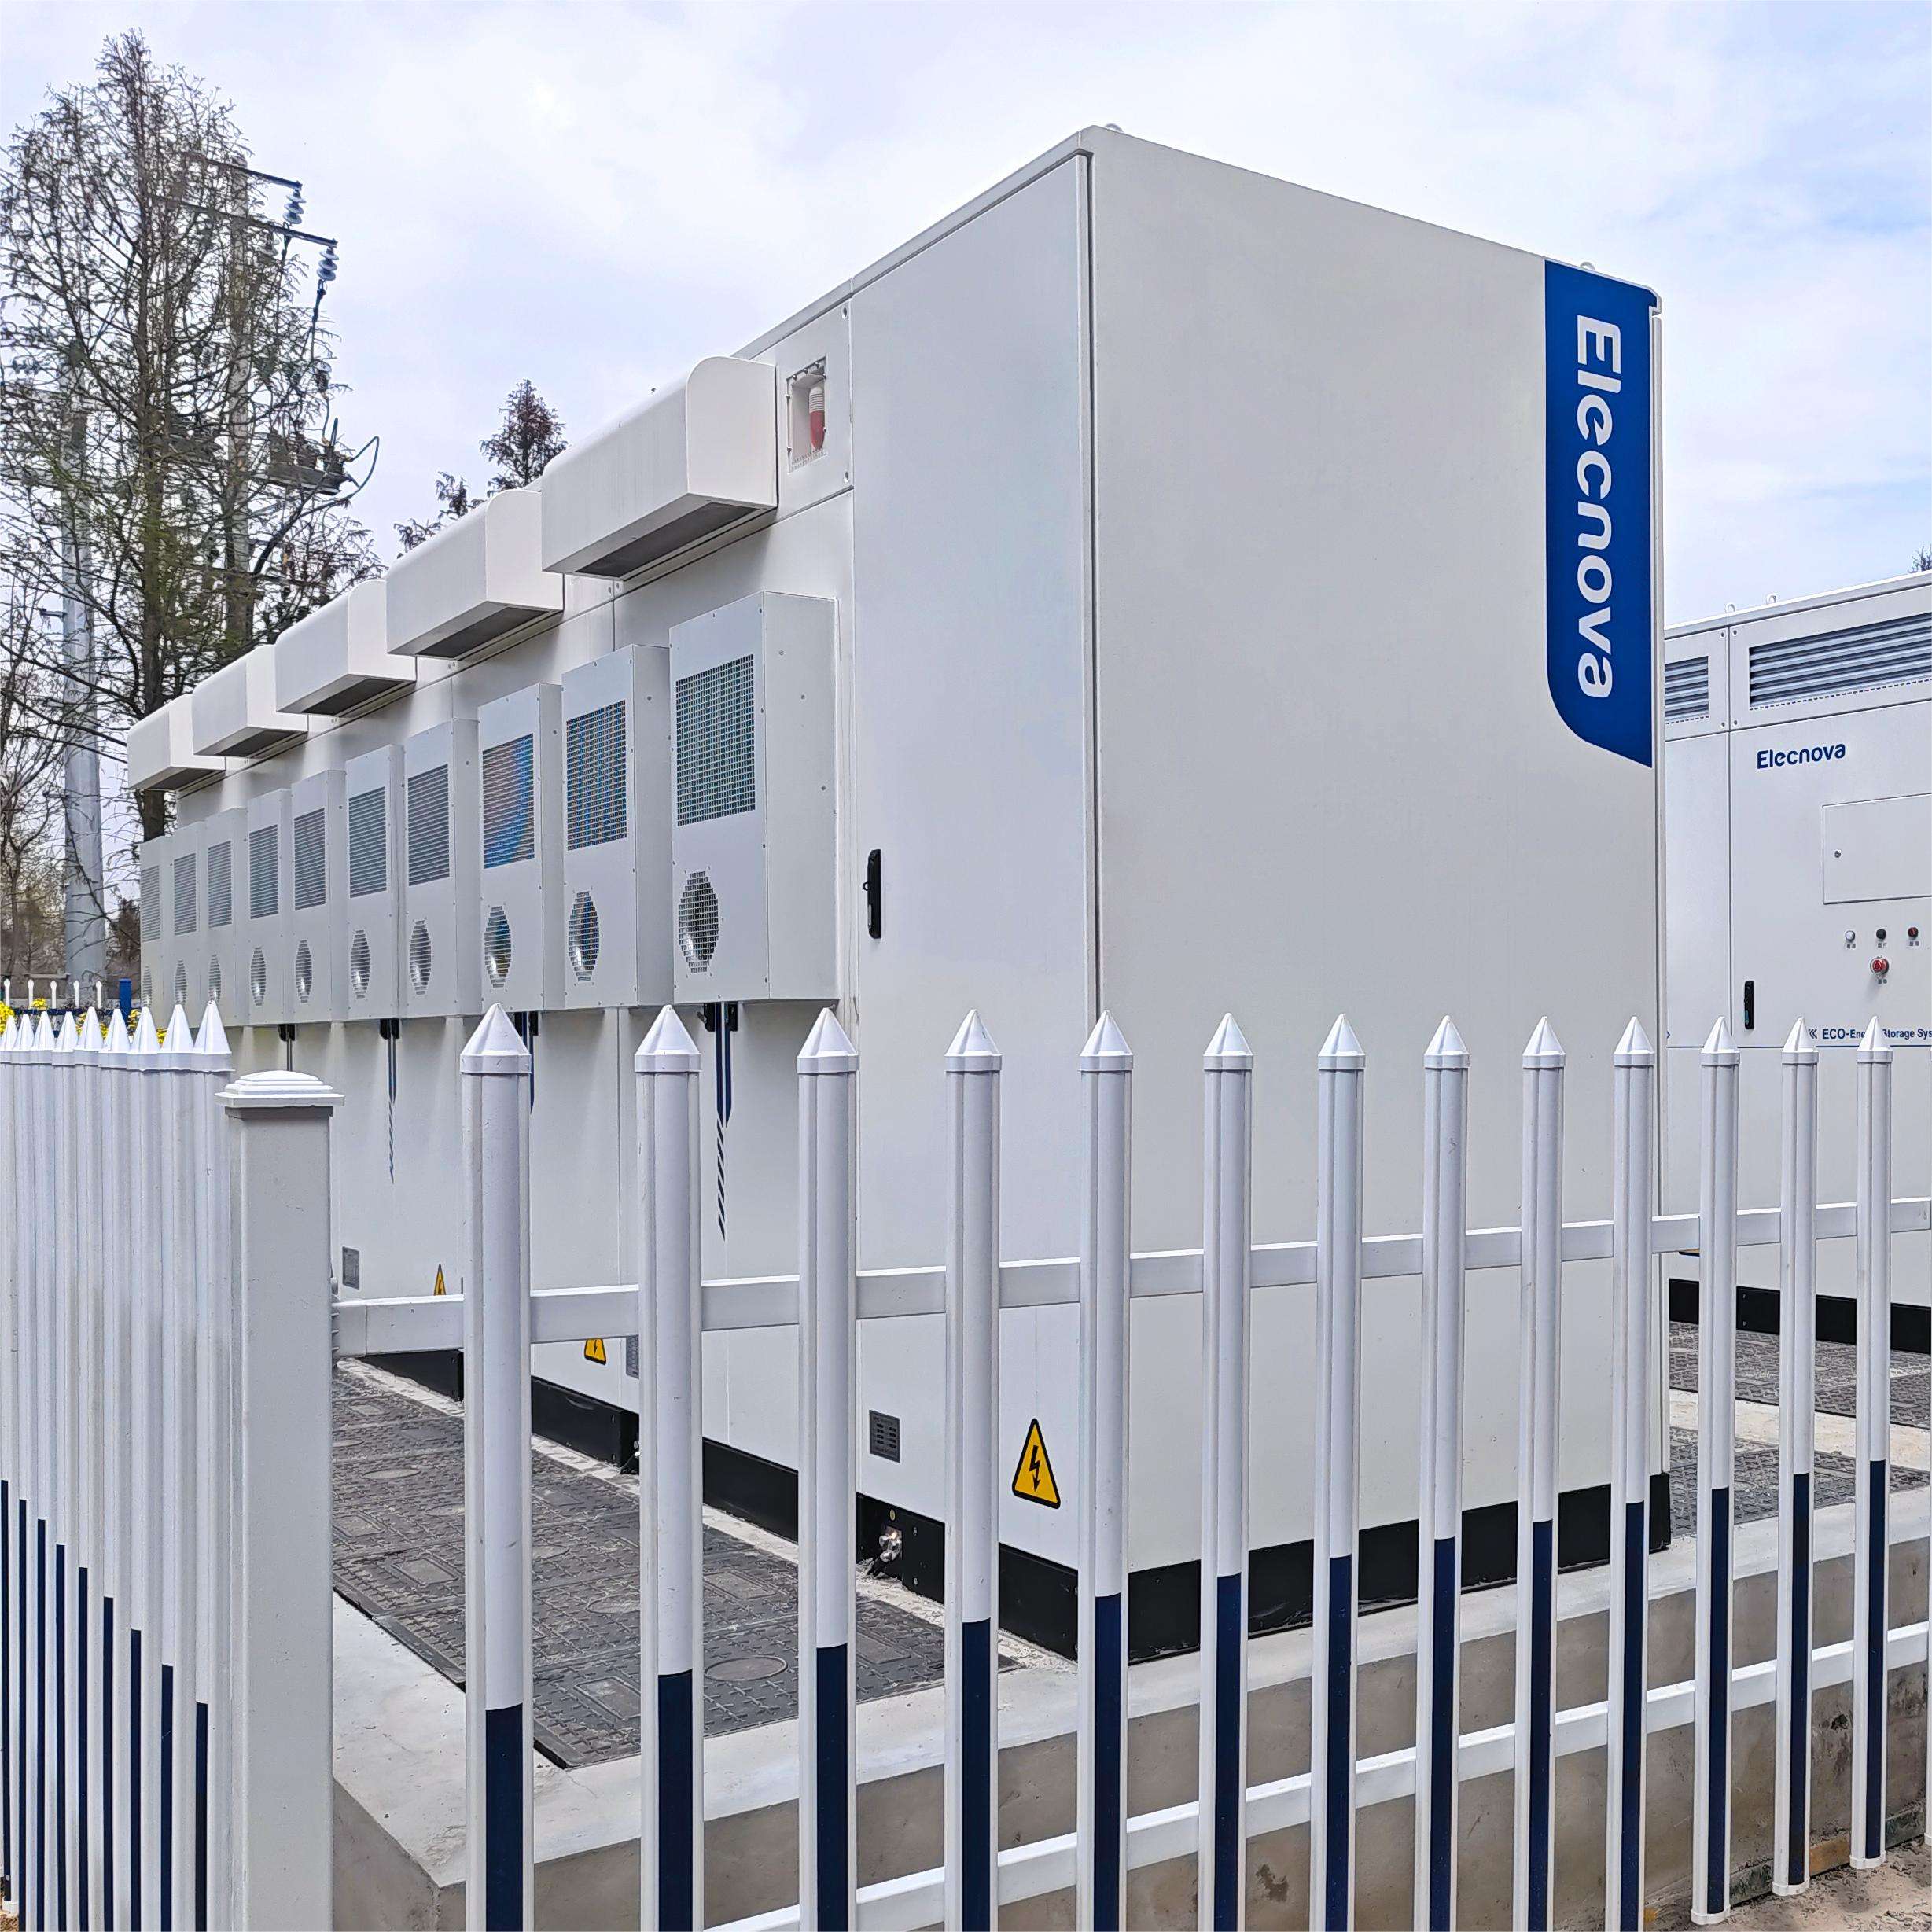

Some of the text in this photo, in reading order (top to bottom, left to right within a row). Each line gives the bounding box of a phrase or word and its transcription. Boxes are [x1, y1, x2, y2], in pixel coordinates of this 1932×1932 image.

[1577, 315, 1621, 698] Elecnova
[1757, 743, 1846, 769] Elecnova
[1822, 1028, 1865, 1040] ECO-Ene
